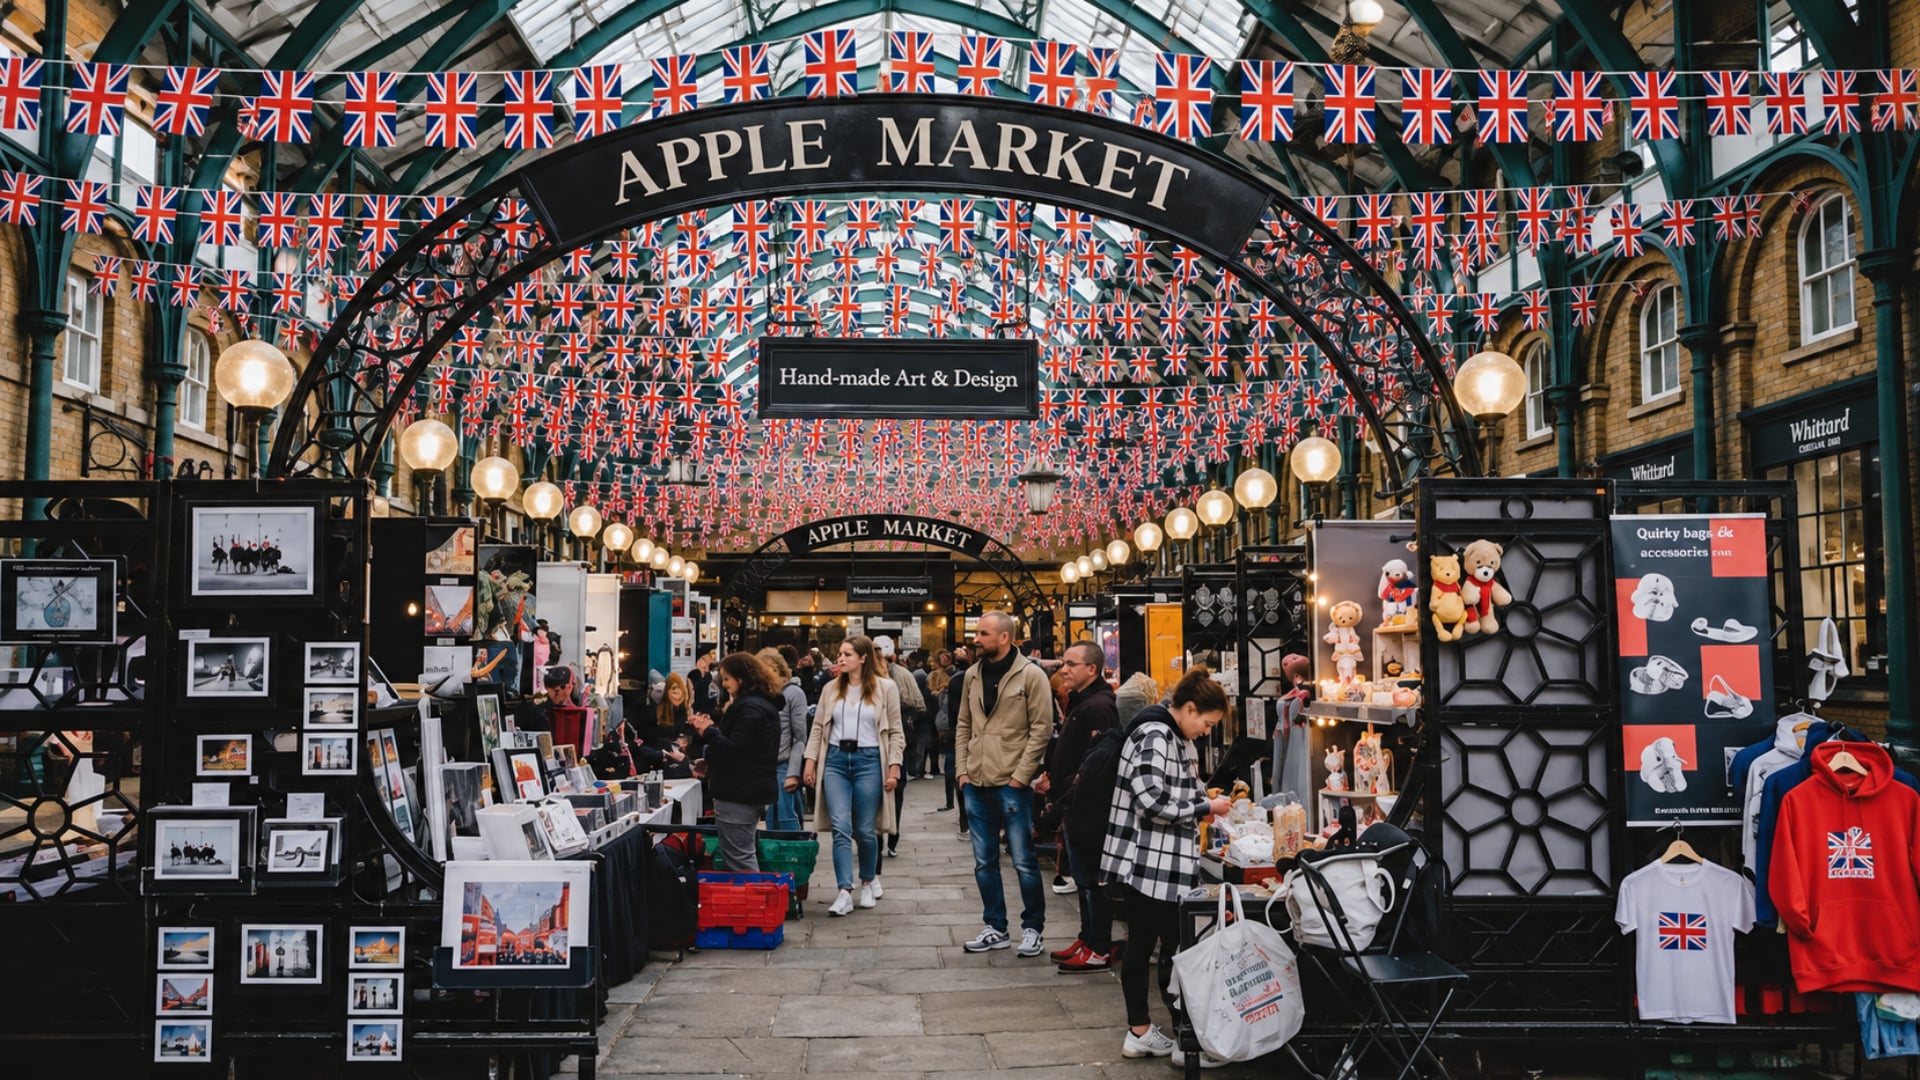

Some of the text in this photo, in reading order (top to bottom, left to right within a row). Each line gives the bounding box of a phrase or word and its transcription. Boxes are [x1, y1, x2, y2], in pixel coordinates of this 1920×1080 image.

[614, 117, 1190, 211] APPLE MARKET
[779, 367, 1018, 392] Hand-made Art & Design
[1790, 408, 1850, 443] Whittard
[1631, 456, 1675, 480] Whittard
[808, 520, 972, 548] APPLE MARKET
[1636, 527, 1680, 541] Quirky
[1683, 527, 1713, 541] bags
[1640, 546, 1708, 558] accessories
